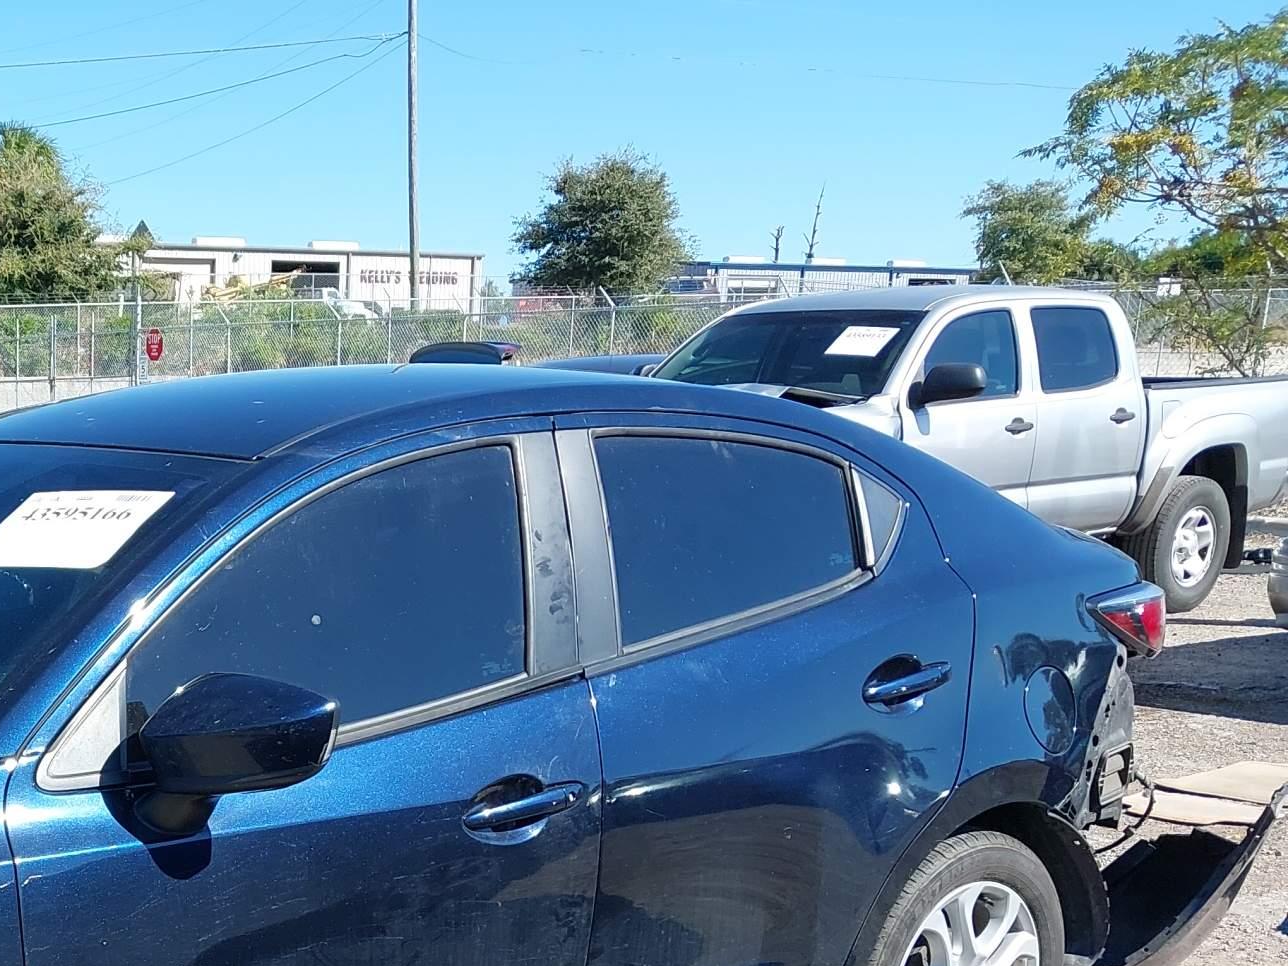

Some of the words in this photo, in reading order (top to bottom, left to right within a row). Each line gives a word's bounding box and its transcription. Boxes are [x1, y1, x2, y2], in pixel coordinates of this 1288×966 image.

[360, 269, 402, 284] KELLY'S
[147, 333, 161, 345] STOP
[22, 507, 132, 521] 43595166
